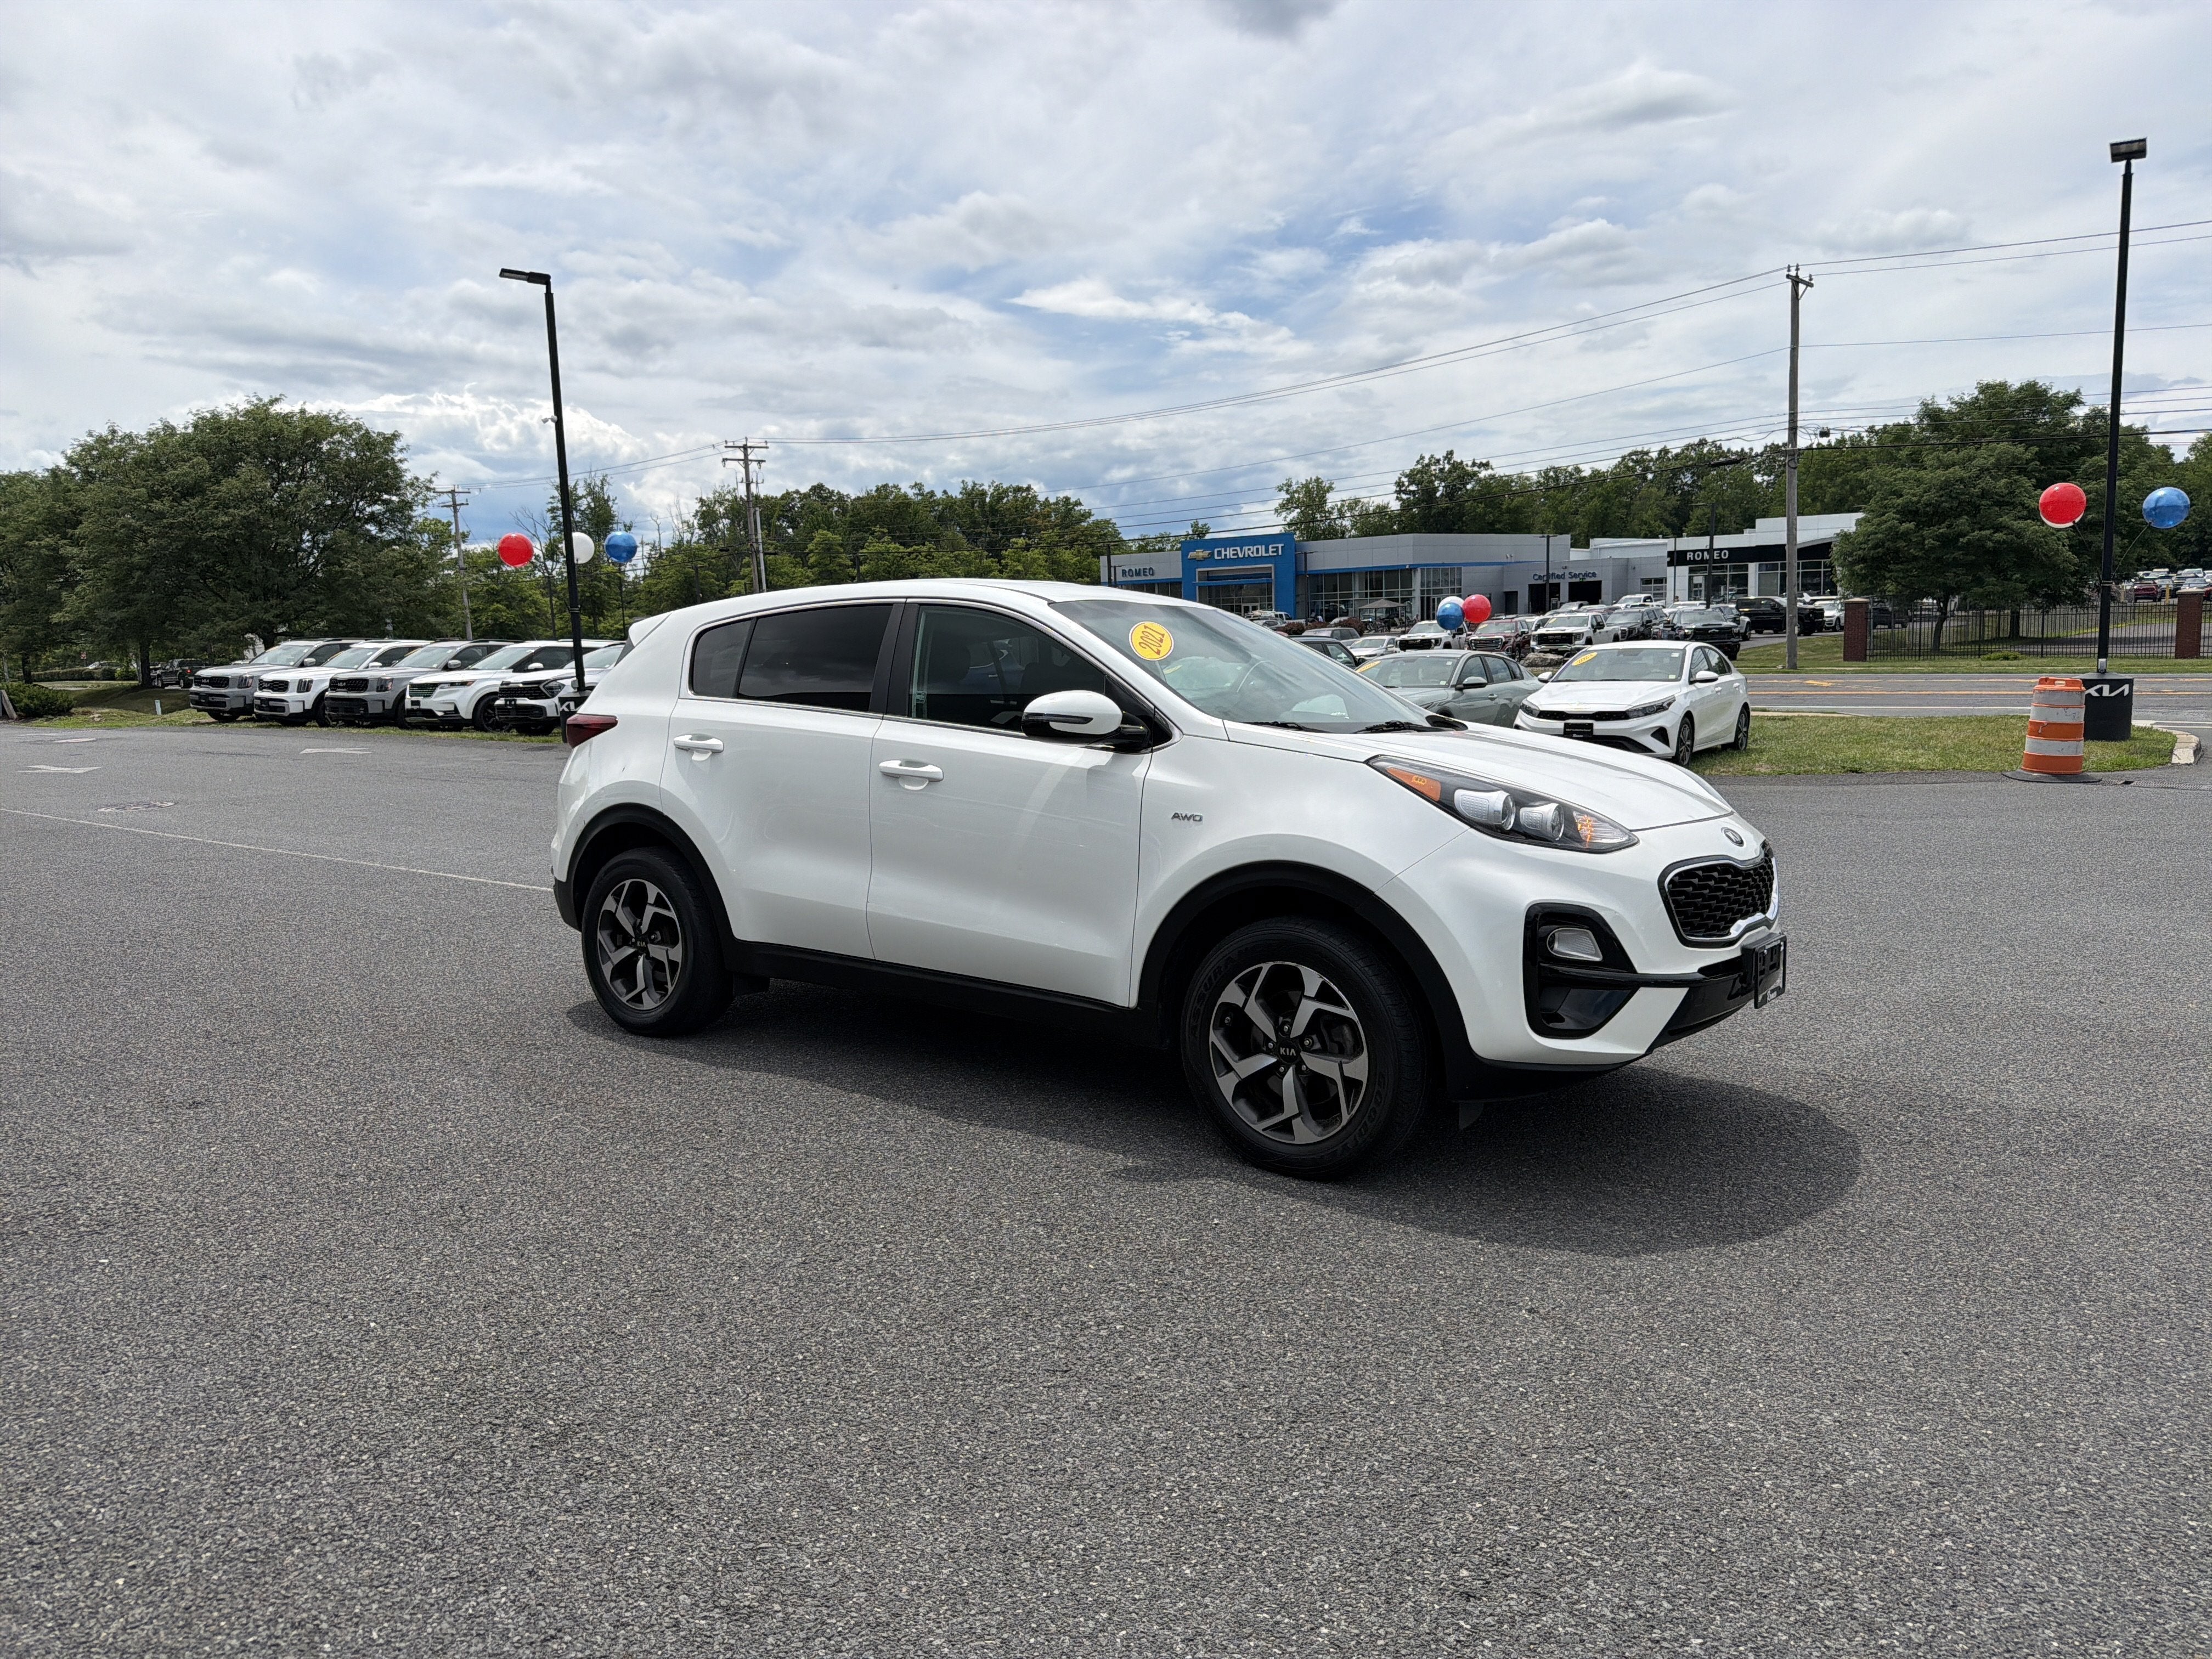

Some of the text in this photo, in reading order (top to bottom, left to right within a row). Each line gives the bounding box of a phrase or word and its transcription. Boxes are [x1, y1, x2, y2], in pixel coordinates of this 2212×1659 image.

[1214, 544, 1284, 560] CHEVROLET
[1686, 550, 1729, 561] ROMEO
[1121, 567, 1155, 578] ROMEO
[1533, 571, 1596, 581] Cerified Service
[1138, 625, 1165, 656] 2021
[2085, 684, 2129, 697] KIA
[1171, 812, 1203, 822] AWD
[1280, 1047, 1296, 1056] KIA
